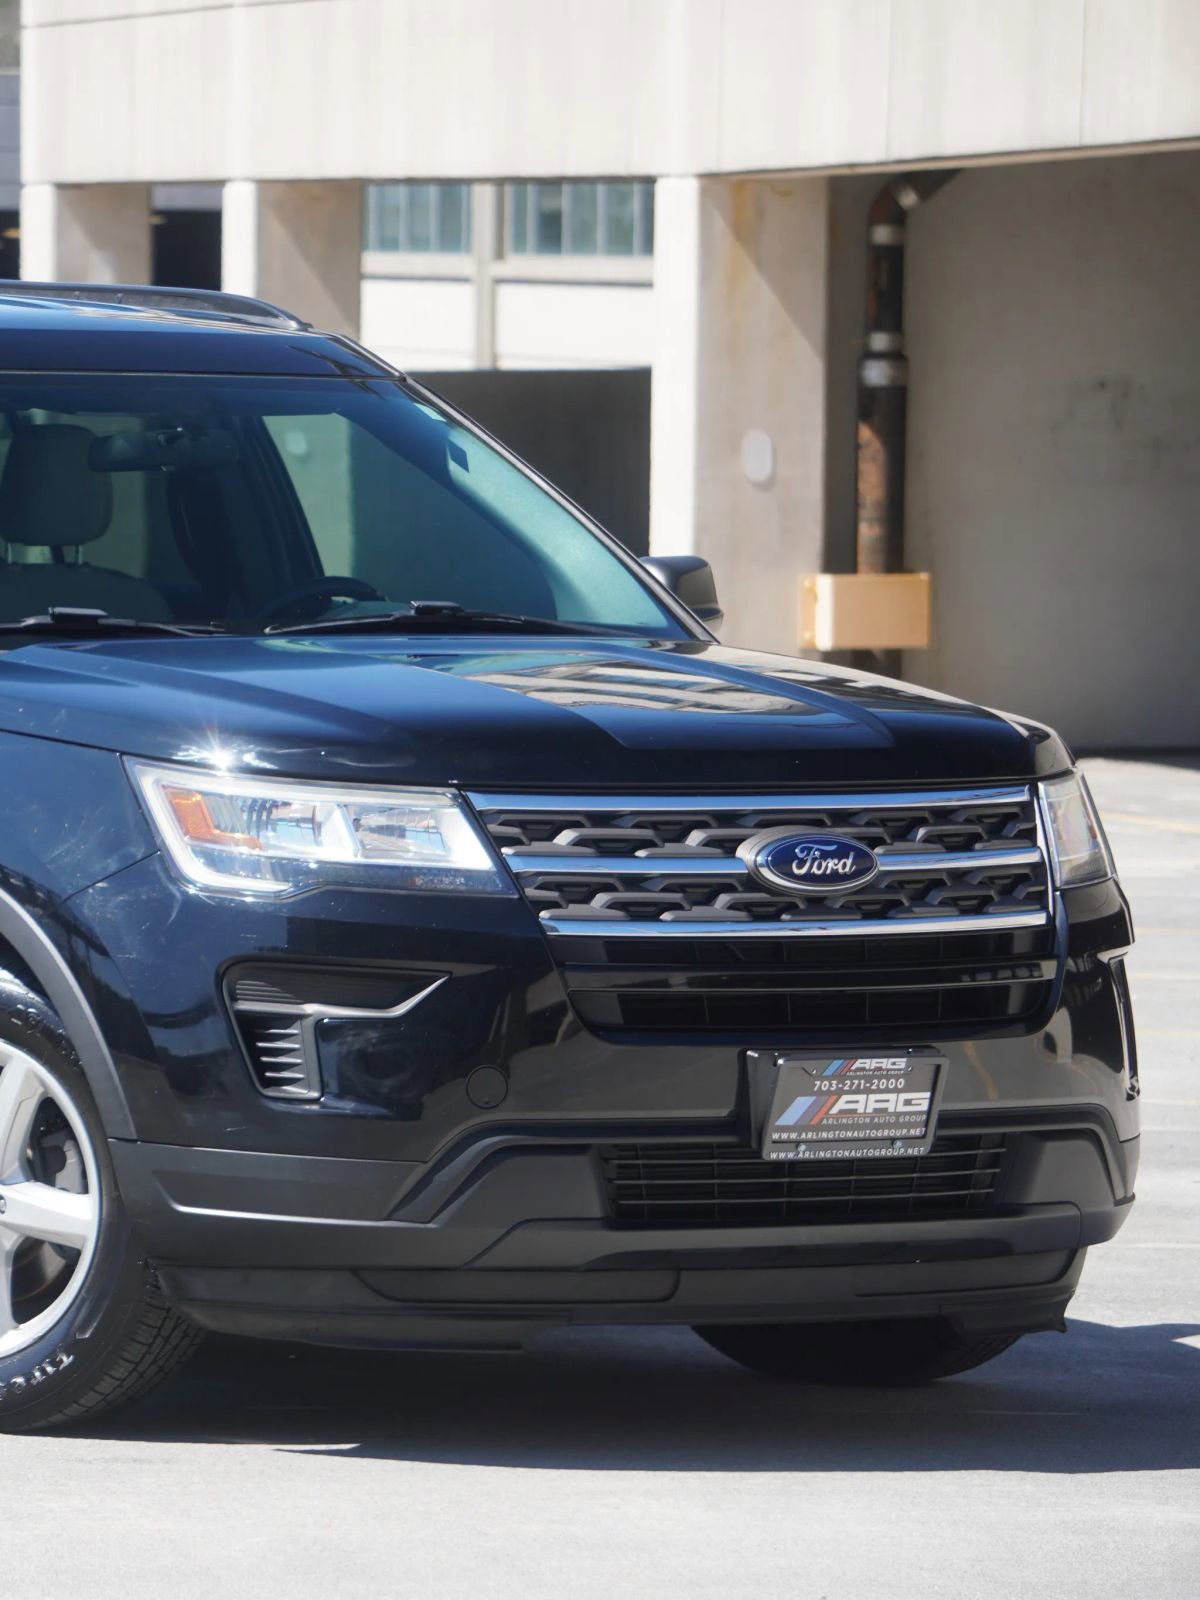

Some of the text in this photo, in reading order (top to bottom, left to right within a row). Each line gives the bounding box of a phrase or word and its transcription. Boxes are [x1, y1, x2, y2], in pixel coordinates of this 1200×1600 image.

[792, 843, 856, 876] Ford
[850, 1058, 907, 1070] AAG
[813, 1079, 905, 1091] 703-271-2000
[828, 1091, 931, 1114] AAG
[821, 1114, 927, 1125] ARLINGTON AUTO GROUP
[771, 1128, 926, 1140] WWW.ARLINGTONAUTOGROUP.NET
[769, 1147, 925, 1160] WWW.ARLINGTONAUTOGROUP.NET
